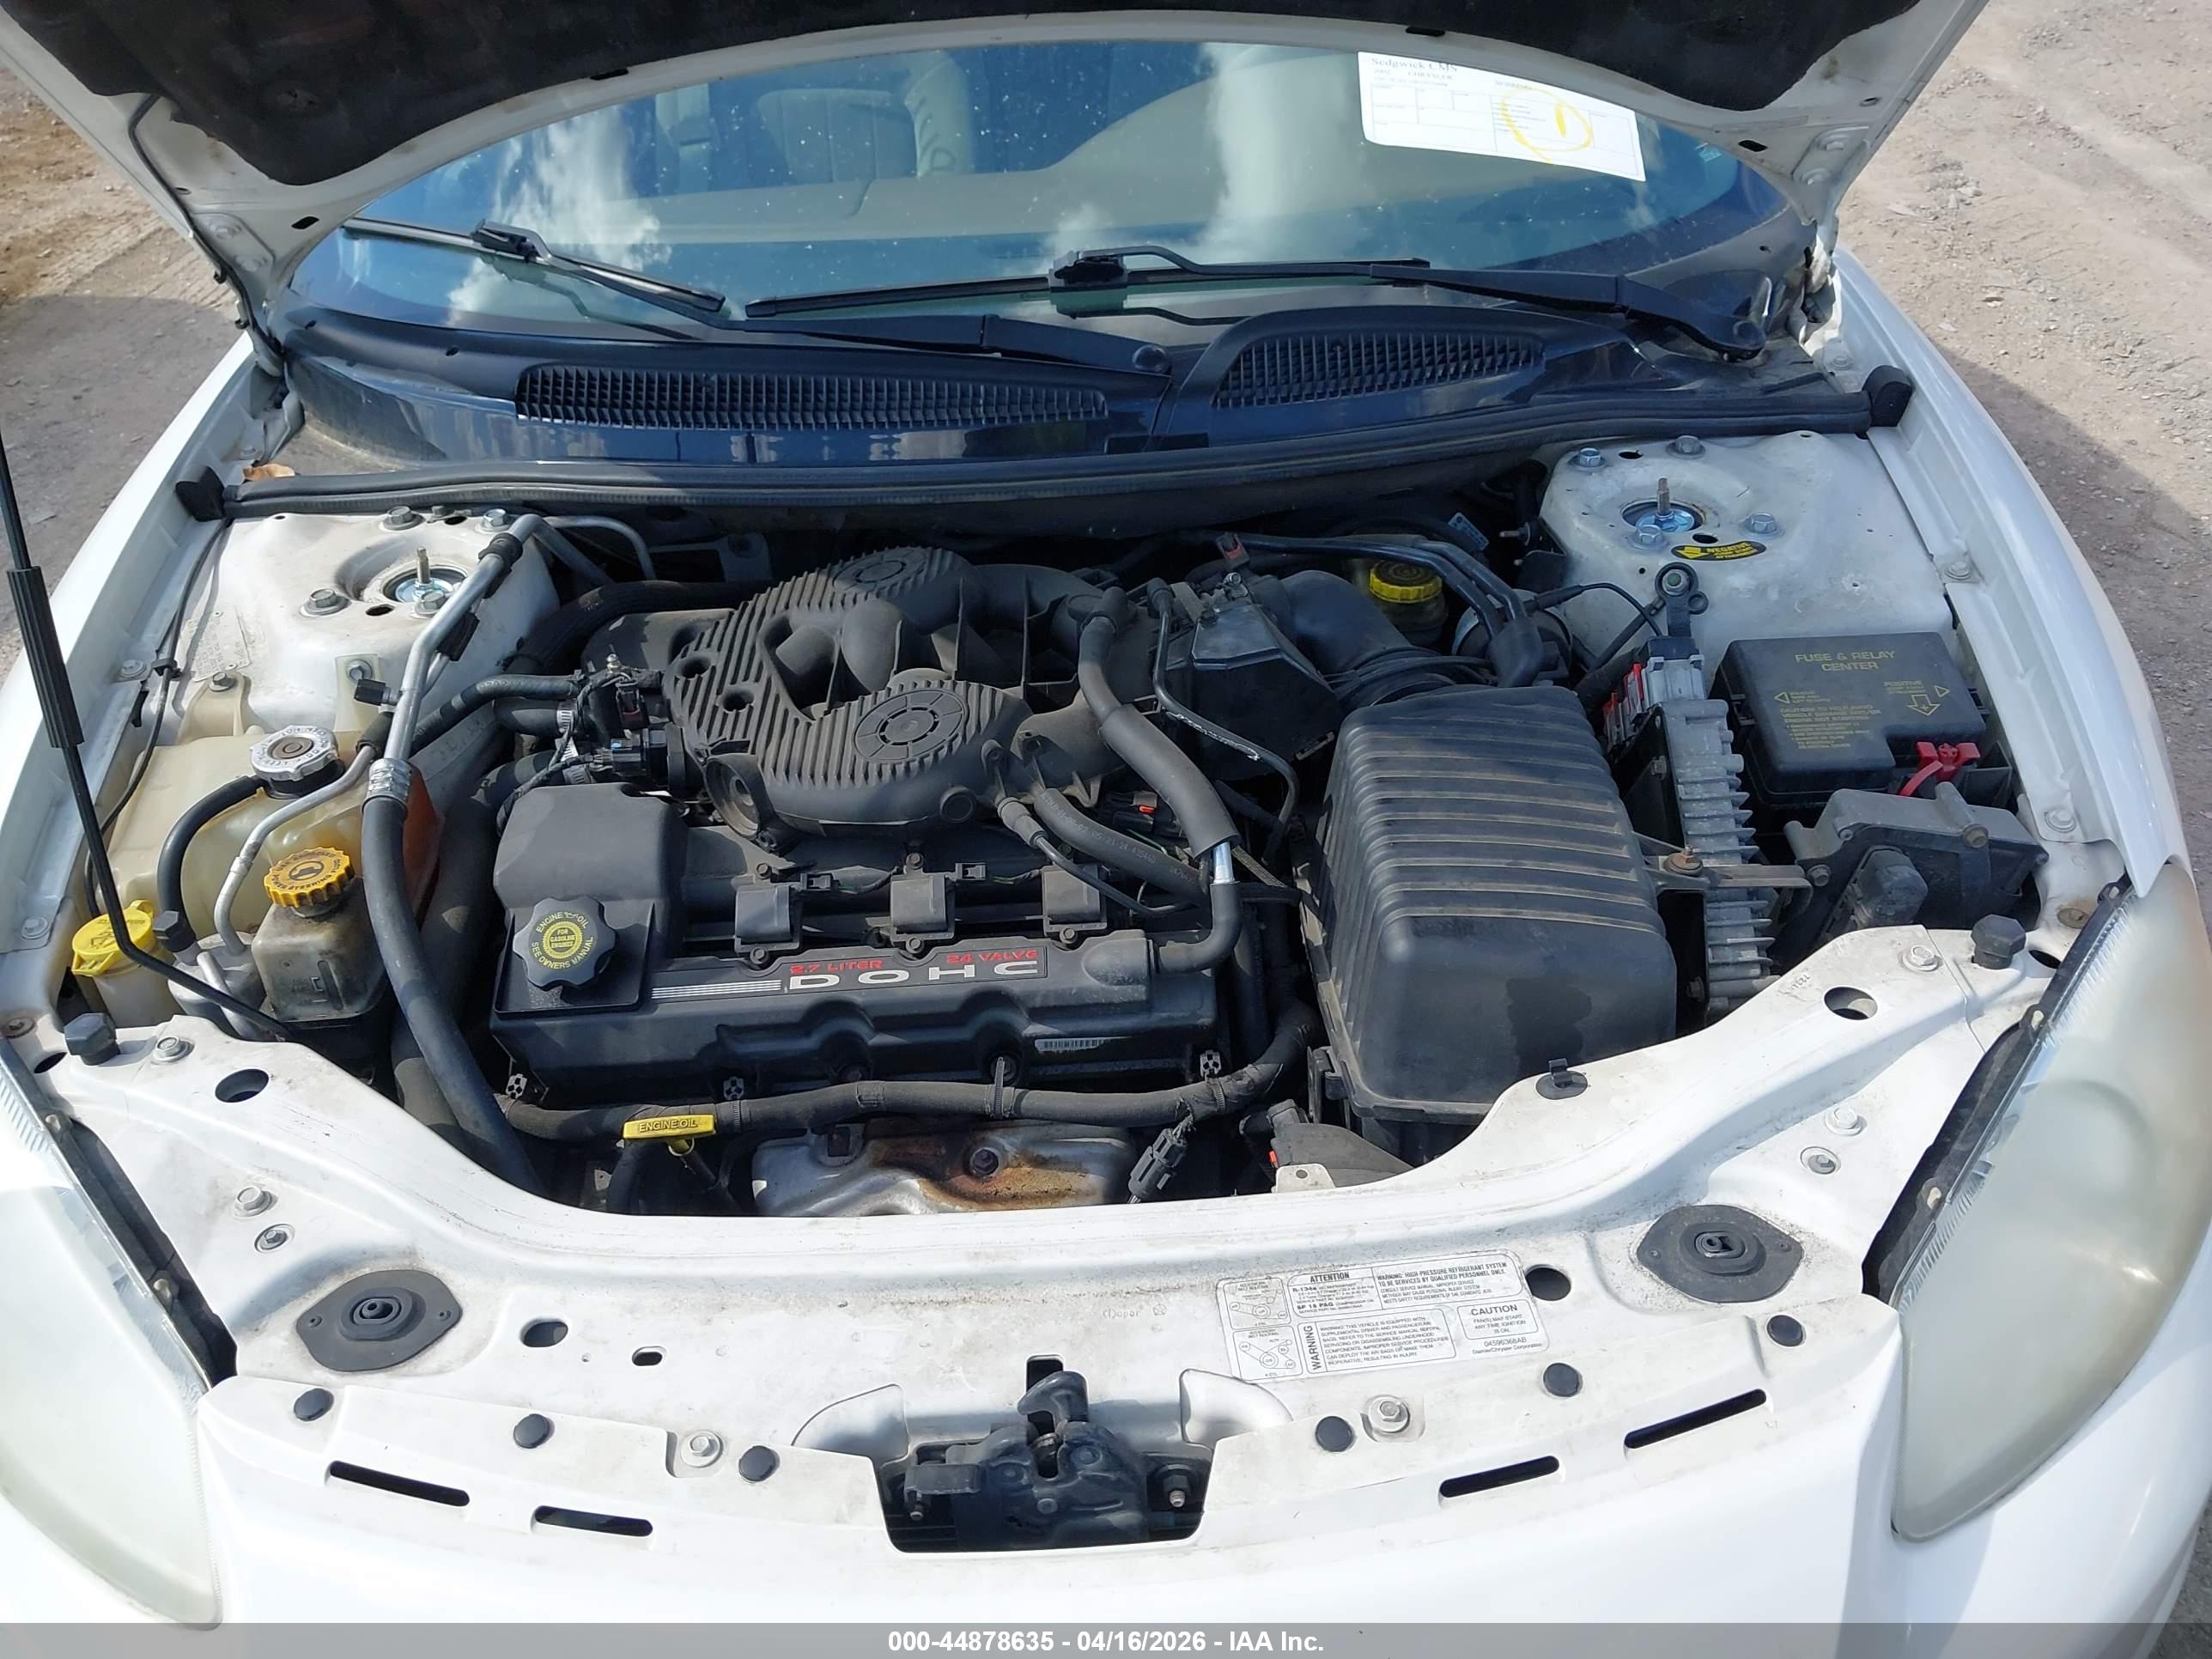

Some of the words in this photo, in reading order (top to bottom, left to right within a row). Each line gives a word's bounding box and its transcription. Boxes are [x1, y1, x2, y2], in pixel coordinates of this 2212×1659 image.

[1371, 58, 1425, 69] Sedgwick
[1429, 63, 1458, 72] CMS
[1795, 653, 1832, 663] FUSE
[1852, 650, 1896, 660] RELAY
[1821, 661, 1879, 672] CENTER
[288, 874, 332, 890] STEERING
[536, 911, 563, 933] ENGINE
[577, 915, 591, 929] OIL
[532, 941, 542, 958] SEE
[538, 955, 571, 969] OWNERS
[571, 936, 593, 964] MANUAL
[946, 952, 973, 963] 24
[978, 949, 1039, 962] VALVE
[790, 963, 821, 975] 2.7
[827, 959, 884, 972] LITER
[789, 960, 1038, 990] DOHC
[639, 1119, 678, 1133] ENGINE
[679, 1118, 697, 1128] OIL
[1310, 1271, 1350, 1283] ATTENTION
[1377, 1273, 1403, 1281] WARNING:
[1419, 1267, 1448, 1276] PRESSURE
[1486, 1261, 1507, 1270] SYSTEM
[1430, 1273, 1458, 1282] QUALIFIED
[1459, 1270, 1491, 1279] PERSONNEL
[1471, 1304, 1517, 1316] CAUTION
[1304, 1325, 1322, 1370] WARNING
